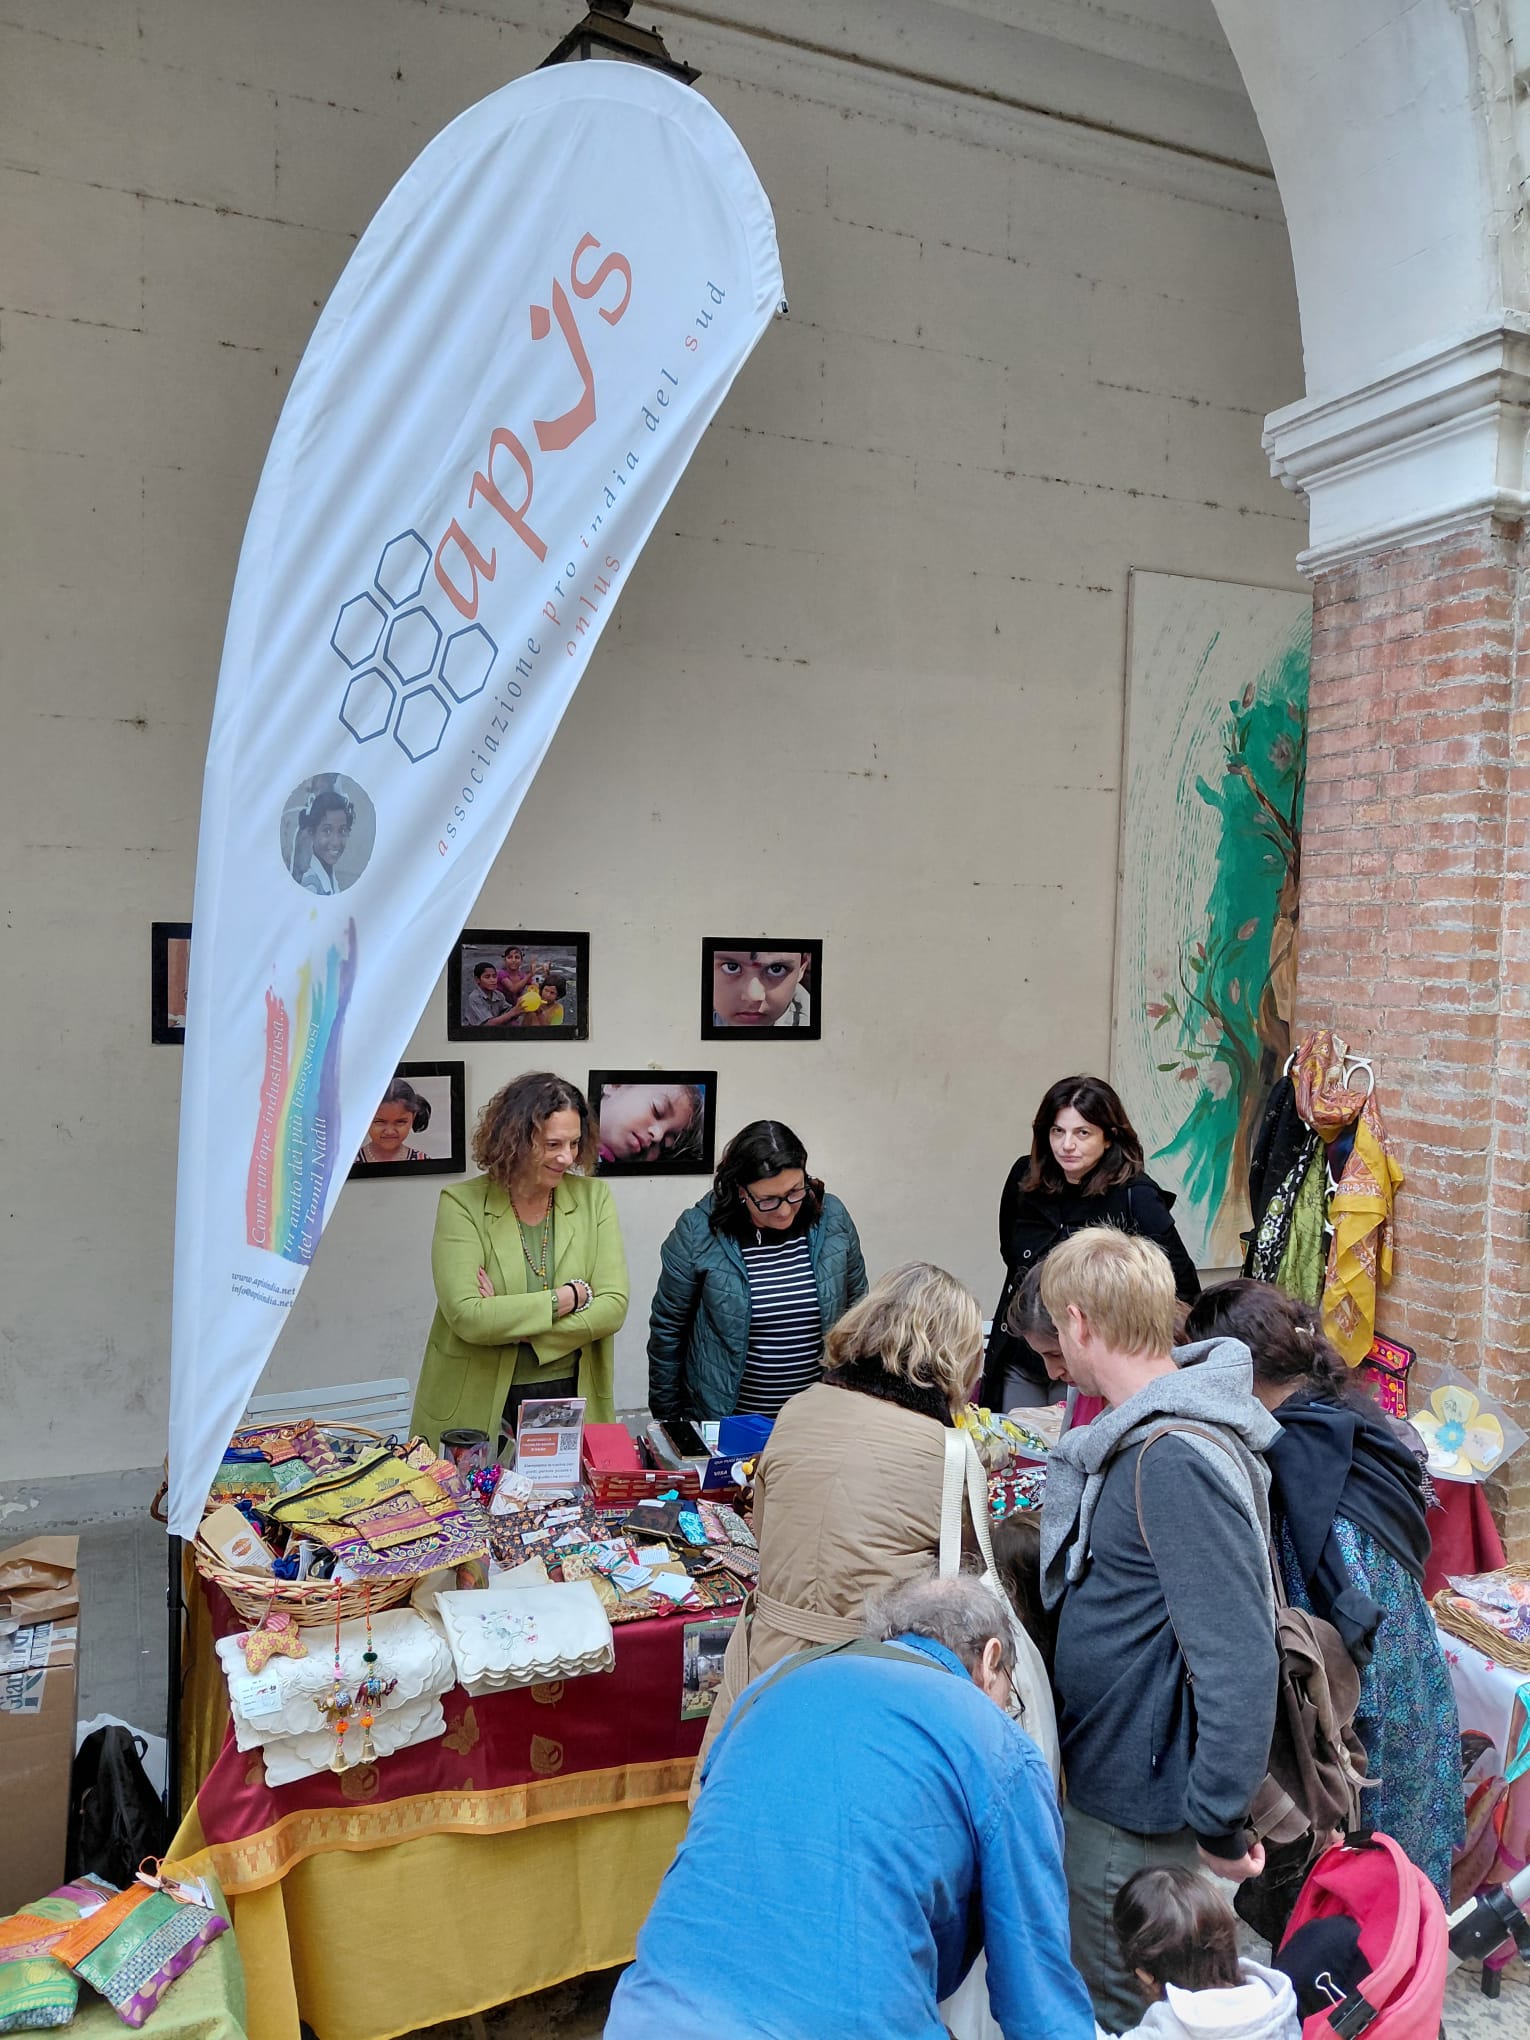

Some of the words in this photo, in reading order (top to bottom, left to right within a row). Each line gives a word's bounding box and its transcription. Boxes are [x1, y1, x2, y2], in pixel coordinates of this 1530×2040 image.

[438, 637, 541, 857] associazione
[542, 561, 577, 627] pro
[579, 450, 639, 549] india
[641, 368, 679, 432] del
[685, 281, 726, 351] sud
[567, 556, 621, 657] onlus
[293, 1023, 320, 1109] bisognosi
[288, 1115, 307, 1147] più
[311, 1116, 327, 1168] Nadu
[256, 1128, 272, 1189] un'ape
[288, 1148, 303, 1176] dei
[251, 1193, 267, 1243] Come
[288, 1180, 303, 1229] aiuto
[304, 1172, 324, 1224] Tamil
[283, 1232, 295, 1253] In
[298, 1230, 312, 1259] del
